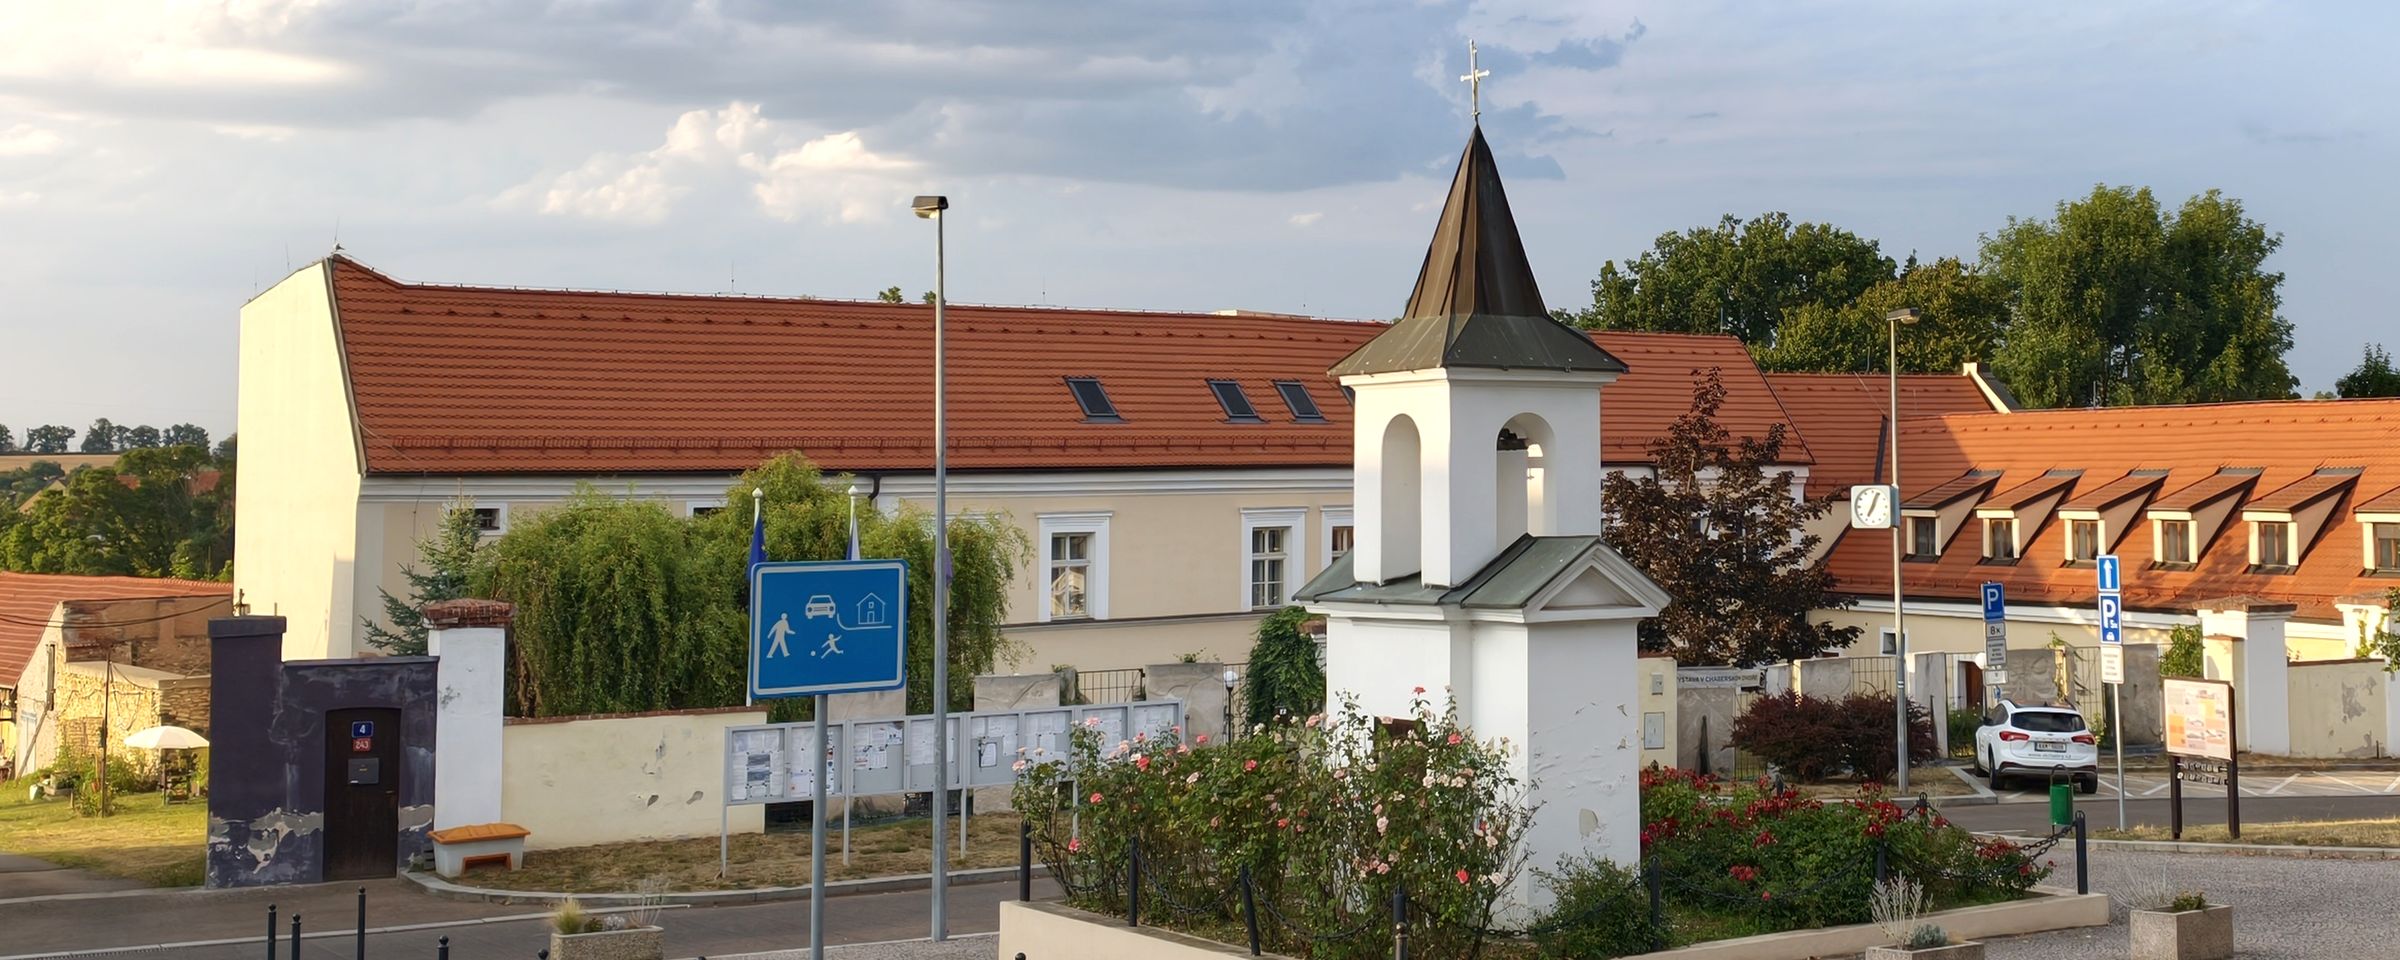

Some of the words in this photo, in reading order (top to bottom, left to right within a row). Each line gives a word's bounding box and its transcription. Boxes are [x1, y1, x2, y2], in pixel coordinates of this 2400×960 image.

[1987, 588, 1999, 610] P
[2102, 599, 2116, 628] P
[1990, 626, 2001, 635] 8x
[359, 724, 366, 734] 4
